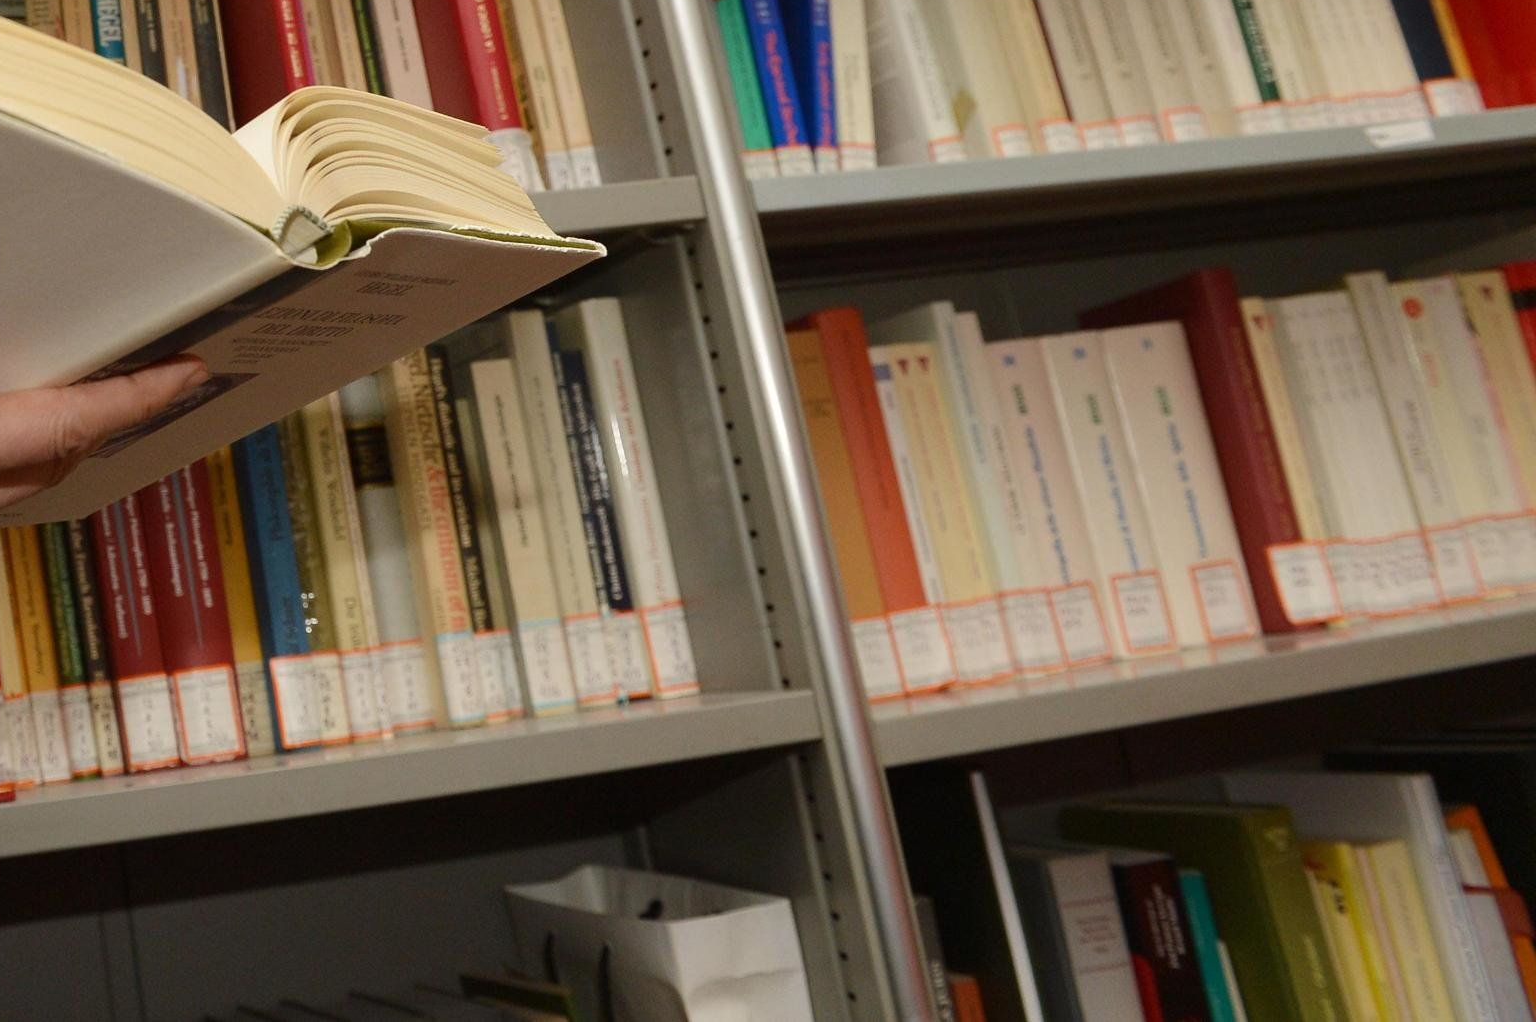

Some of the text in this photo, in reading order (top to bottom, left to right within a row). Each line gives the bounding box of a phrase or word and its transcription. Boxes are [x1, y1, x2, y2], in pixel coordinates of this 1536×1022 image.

[412, 384, 443, 465] Nietzsche
[430, 356, 447, 400] Hegel's
[447, 452, 461, 475] and
[454, 493, 474, 549] criticism
[425, 465, 446, 483] &
[428, 484, 450, 513] the
[433, 513, 460, 590] criticism
